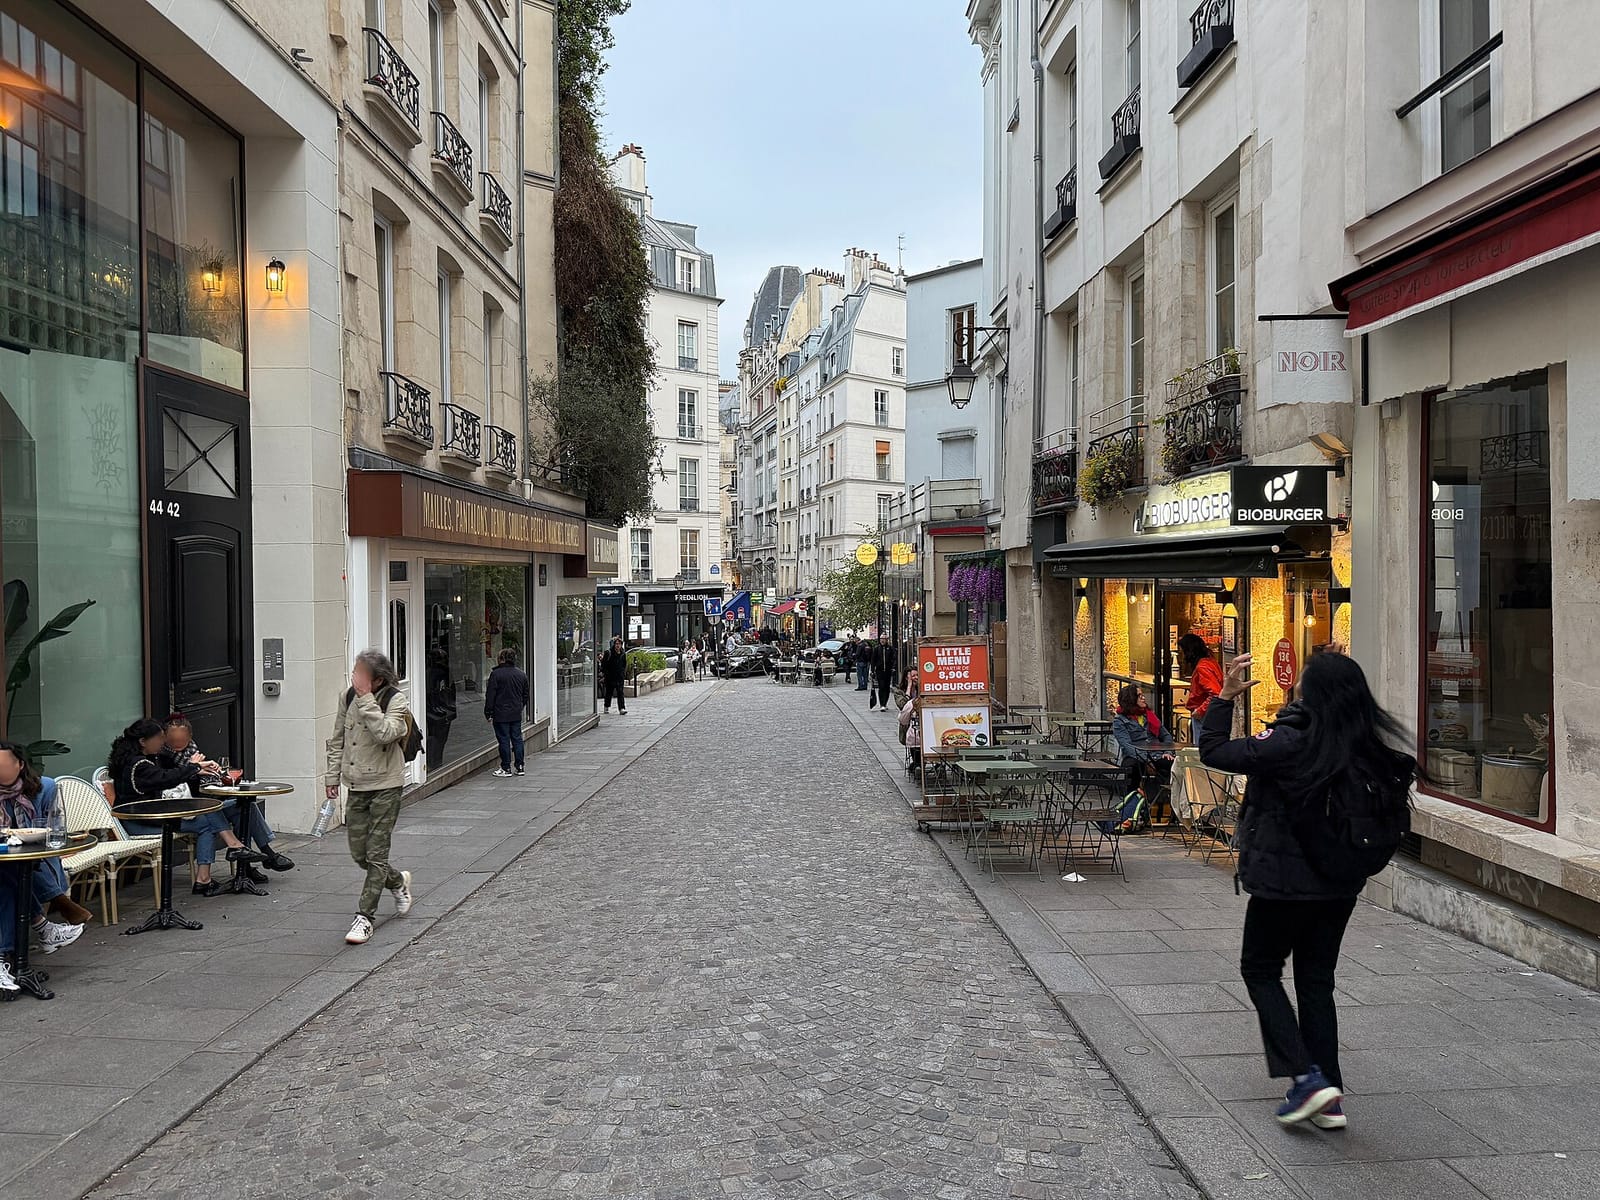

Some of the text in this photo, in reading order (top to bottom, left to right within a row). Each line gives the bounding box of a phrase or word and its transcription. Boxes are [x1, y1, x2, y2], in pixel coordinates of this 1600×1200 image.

[1277, 350, 1347, 373] NOIR
[149, 499, 181, 518] 44 42
[423, 491, 454, 533] MAILLES,
[1150, 491, 1231, 527] BIOBURGER
[1238, 508, 1324, 521] BIOBURGER
[935, 647, 972, 657] LITTLE
[937, 656, 970, 666] MENU
[938, 671, 969, 681] 8,90€
[924, 682, 985, 692] BIOBURGER
